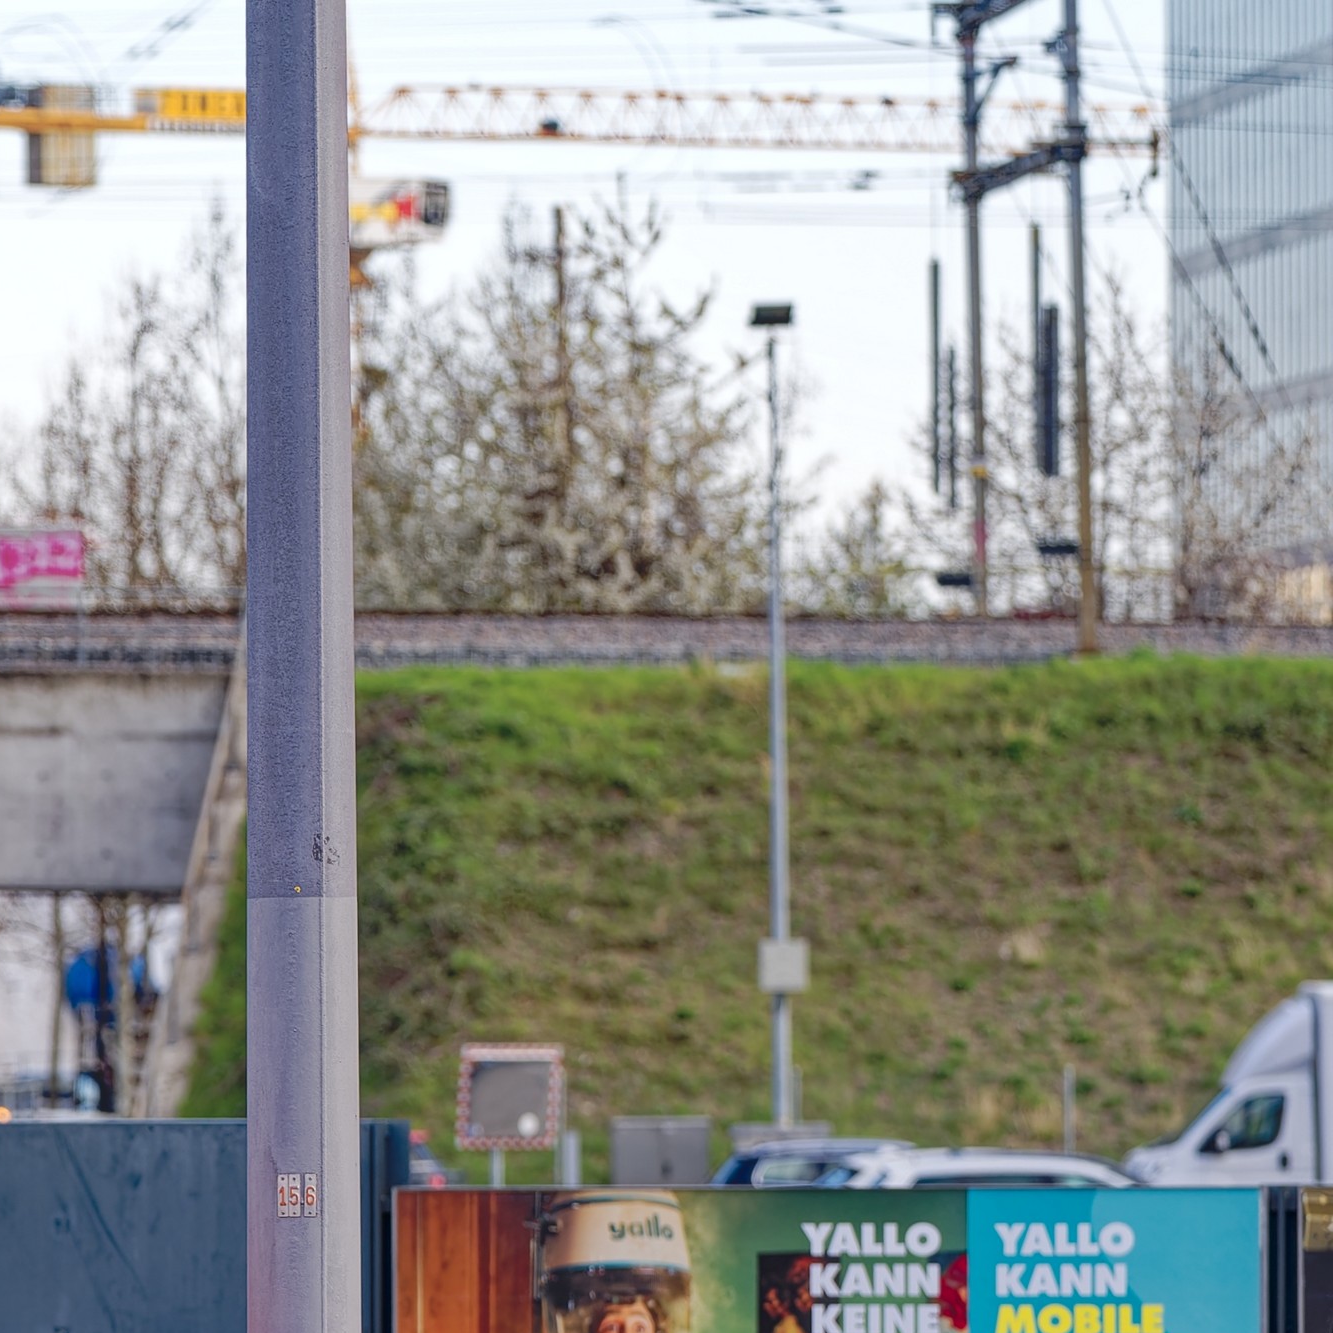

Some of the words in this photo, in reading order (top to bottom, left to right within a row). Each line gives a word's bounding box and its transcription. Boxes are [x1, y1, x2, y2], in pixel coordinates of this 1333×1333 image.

[609, 1213, 673, 1241] yallo
[801, 1222, 941, 1257] YALLO
[995, 1222, 1135, 1257] YALLO
[809, 1263, 941, 1297] KANN
[995, 1263, 1127, 1297] KANN
